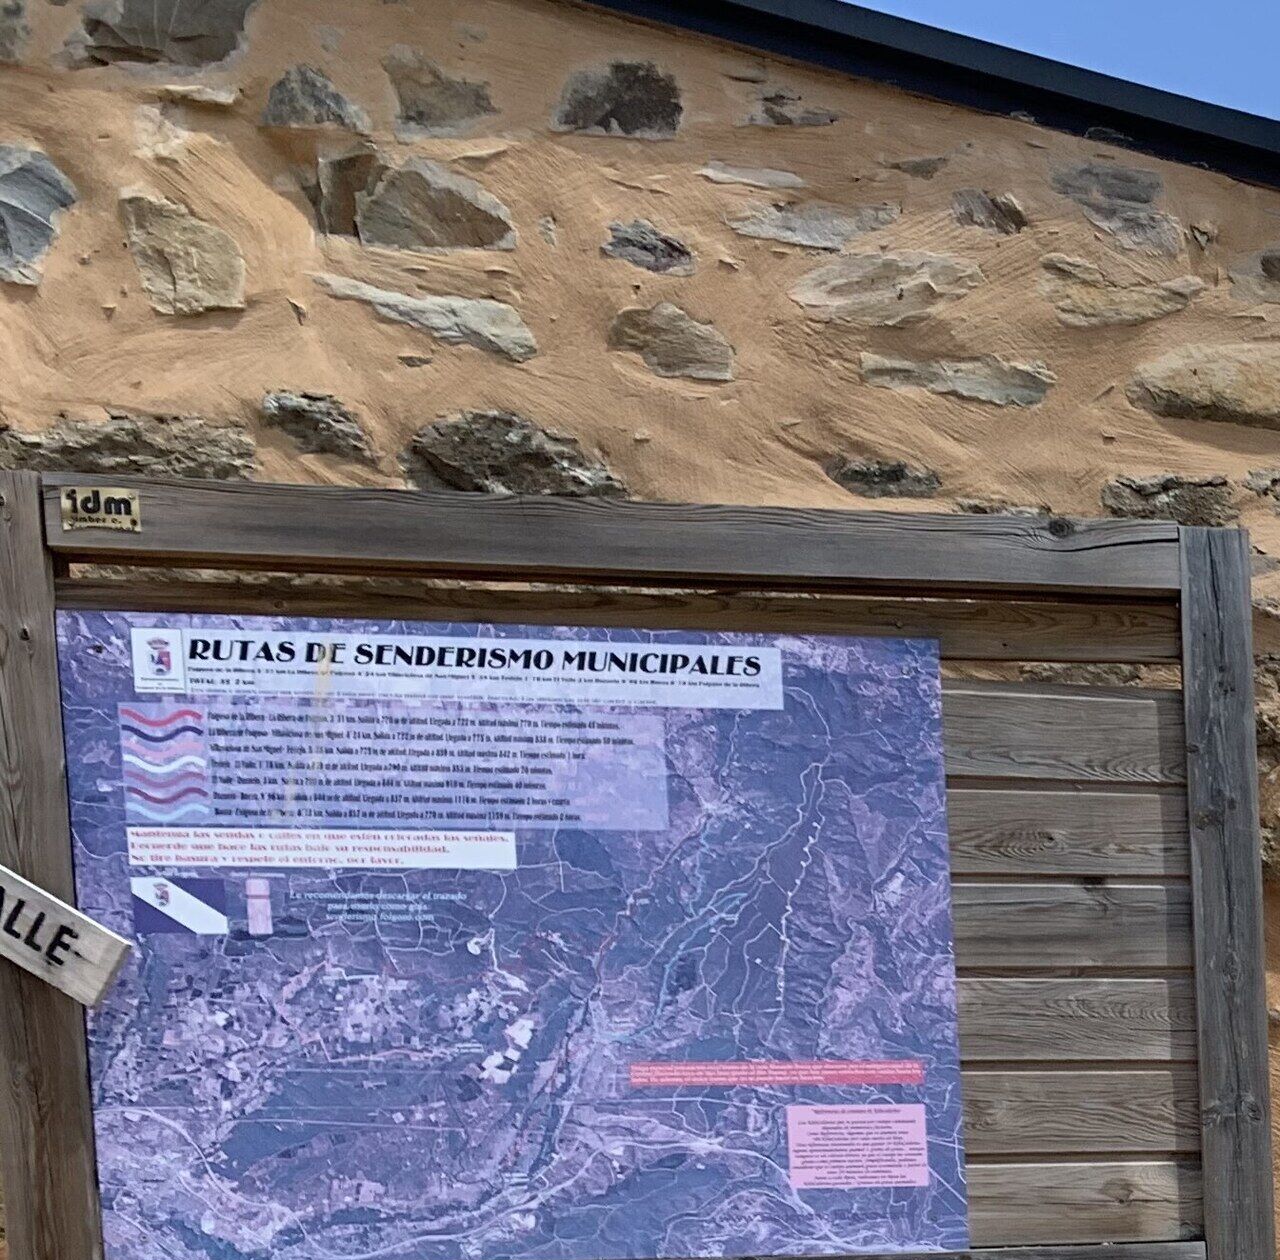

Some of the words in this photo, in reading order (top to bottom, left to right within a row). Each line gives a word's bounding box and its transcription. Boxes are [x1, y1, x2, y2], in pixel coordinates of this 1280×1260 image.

[66, 488, 132, 515] idm
[188, 638, 295, 662] RUTAS
[306, 642, 346, 664] DE
[354, 644, 553, 670] SENDERISMO
[561, 650, 761, 676] MUNICIPALES
